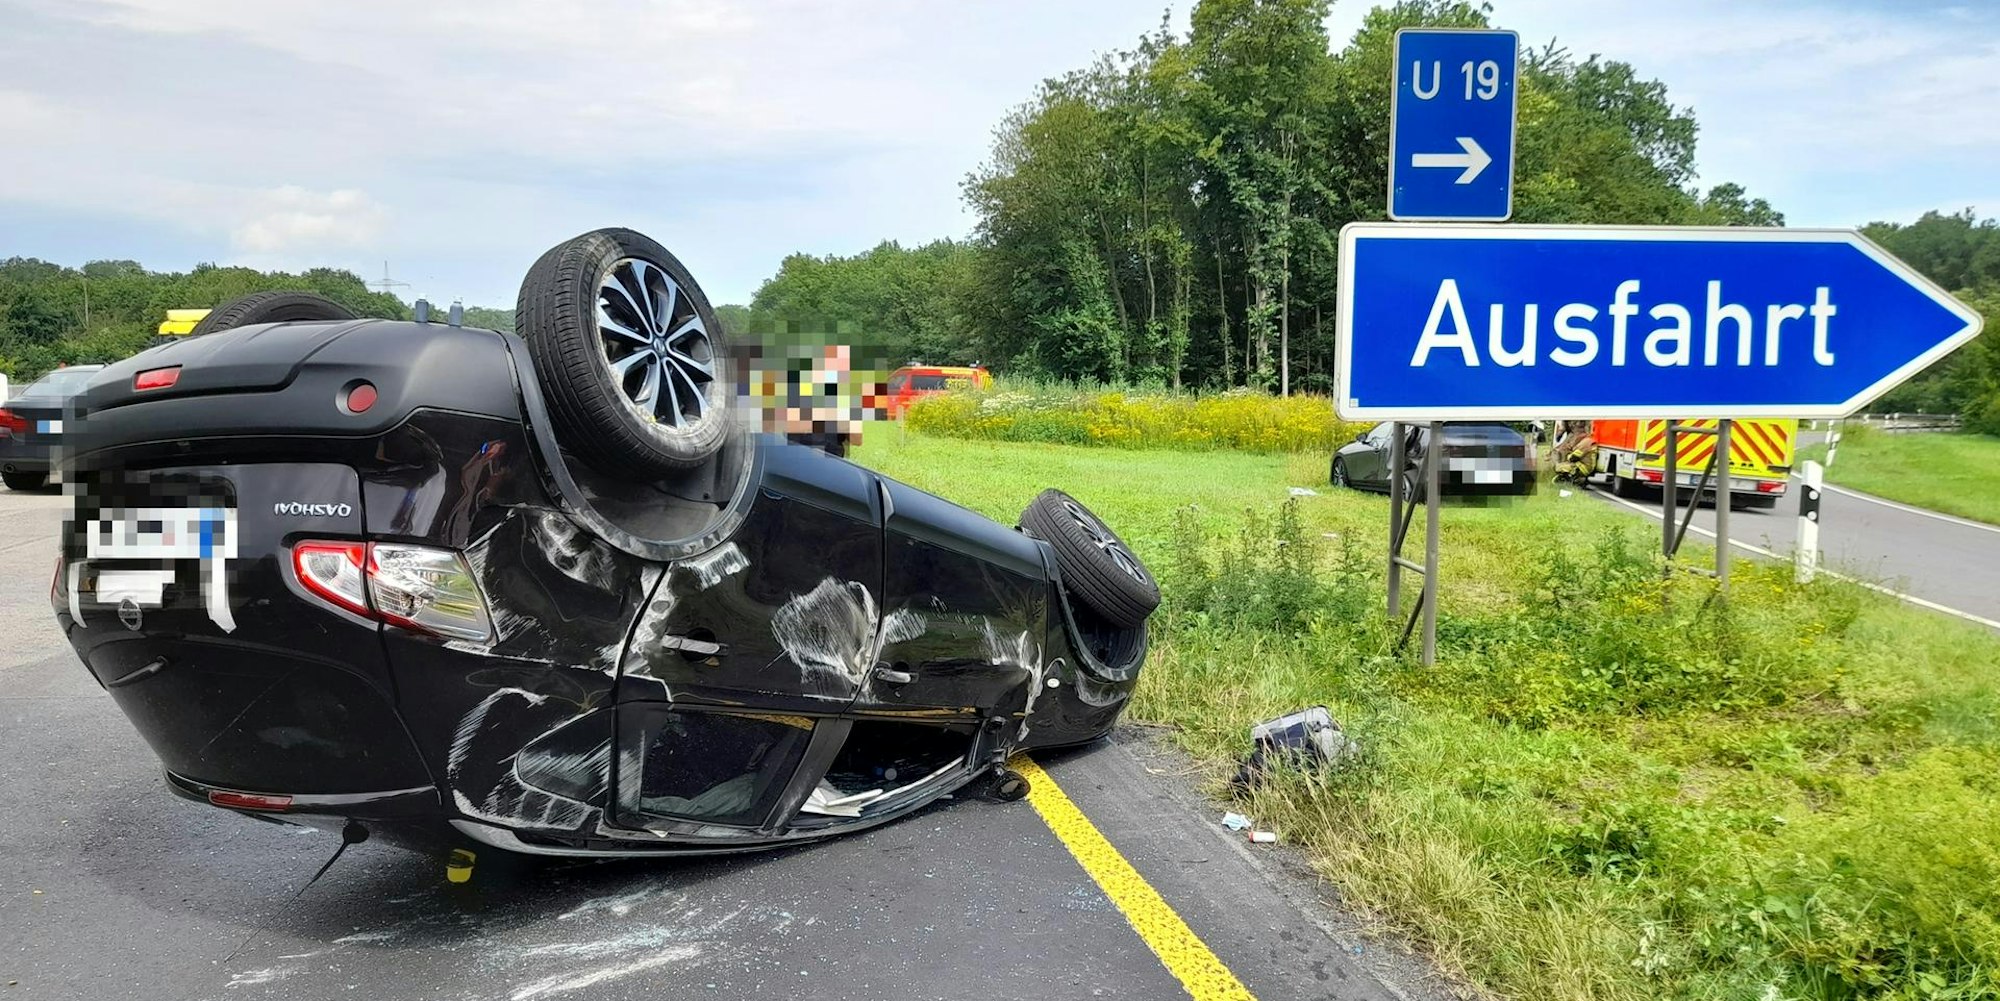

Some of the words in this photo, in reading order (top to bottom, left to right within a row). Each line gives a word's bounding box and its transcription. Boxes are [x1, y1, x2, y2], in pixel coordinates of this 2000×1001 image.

[1413, 61, 1440, 99] U
[1462, 61, 1498, 99] 19
[1410, 279, 1836, 367] Ausfahrt
[274, 502, 351, 516] QASHQAI
